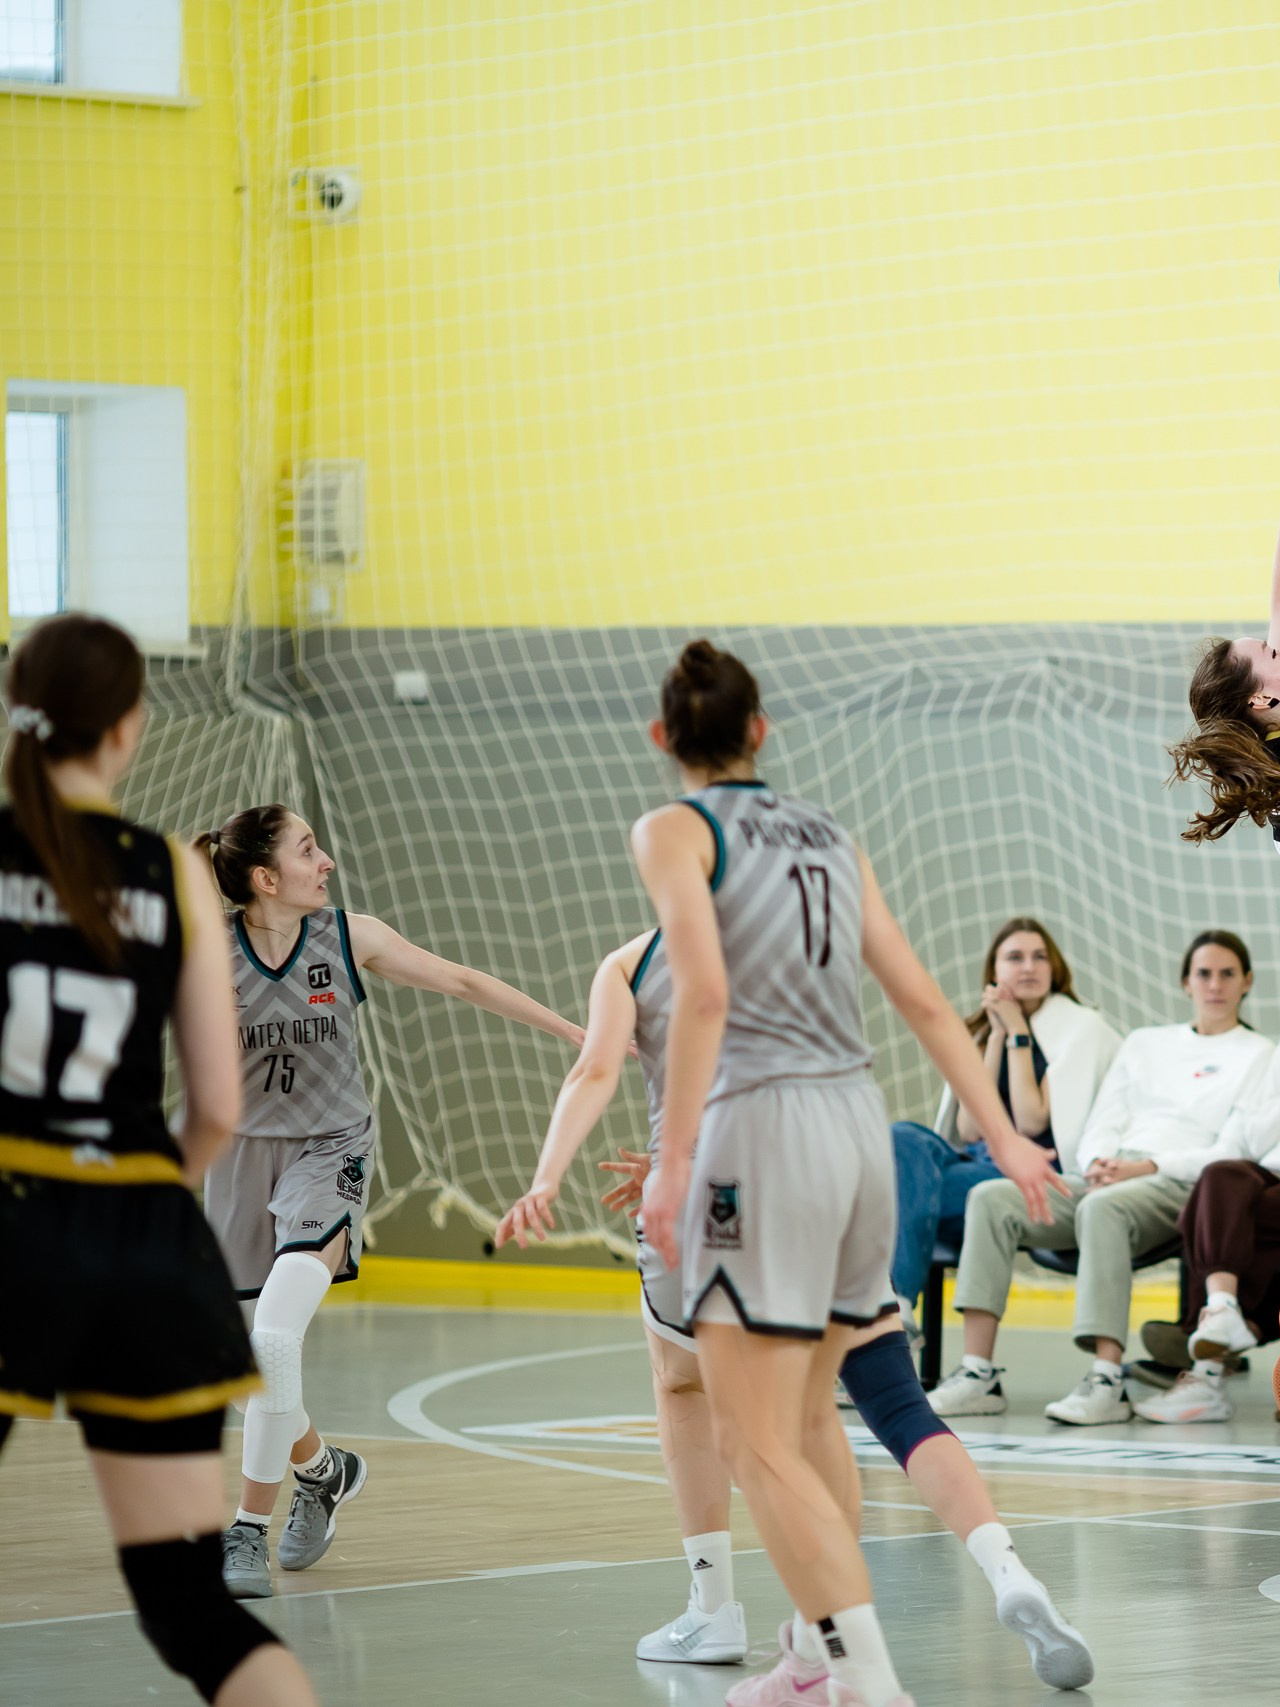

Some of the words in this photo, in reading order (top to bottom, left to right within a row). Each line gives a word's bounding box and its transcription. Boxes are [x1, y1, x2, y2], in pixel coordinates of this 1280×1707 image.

[787, 864, 832, 968] 17
[0, 961, 137, 1101] 17
[237, 1021, 287, 1050] ЛИТЕХ
[293, 1015, 338, 1045] ПЕТРА
[263, 1054, 295, 1094] 75
[301, 1221, 325, 1230] STK
